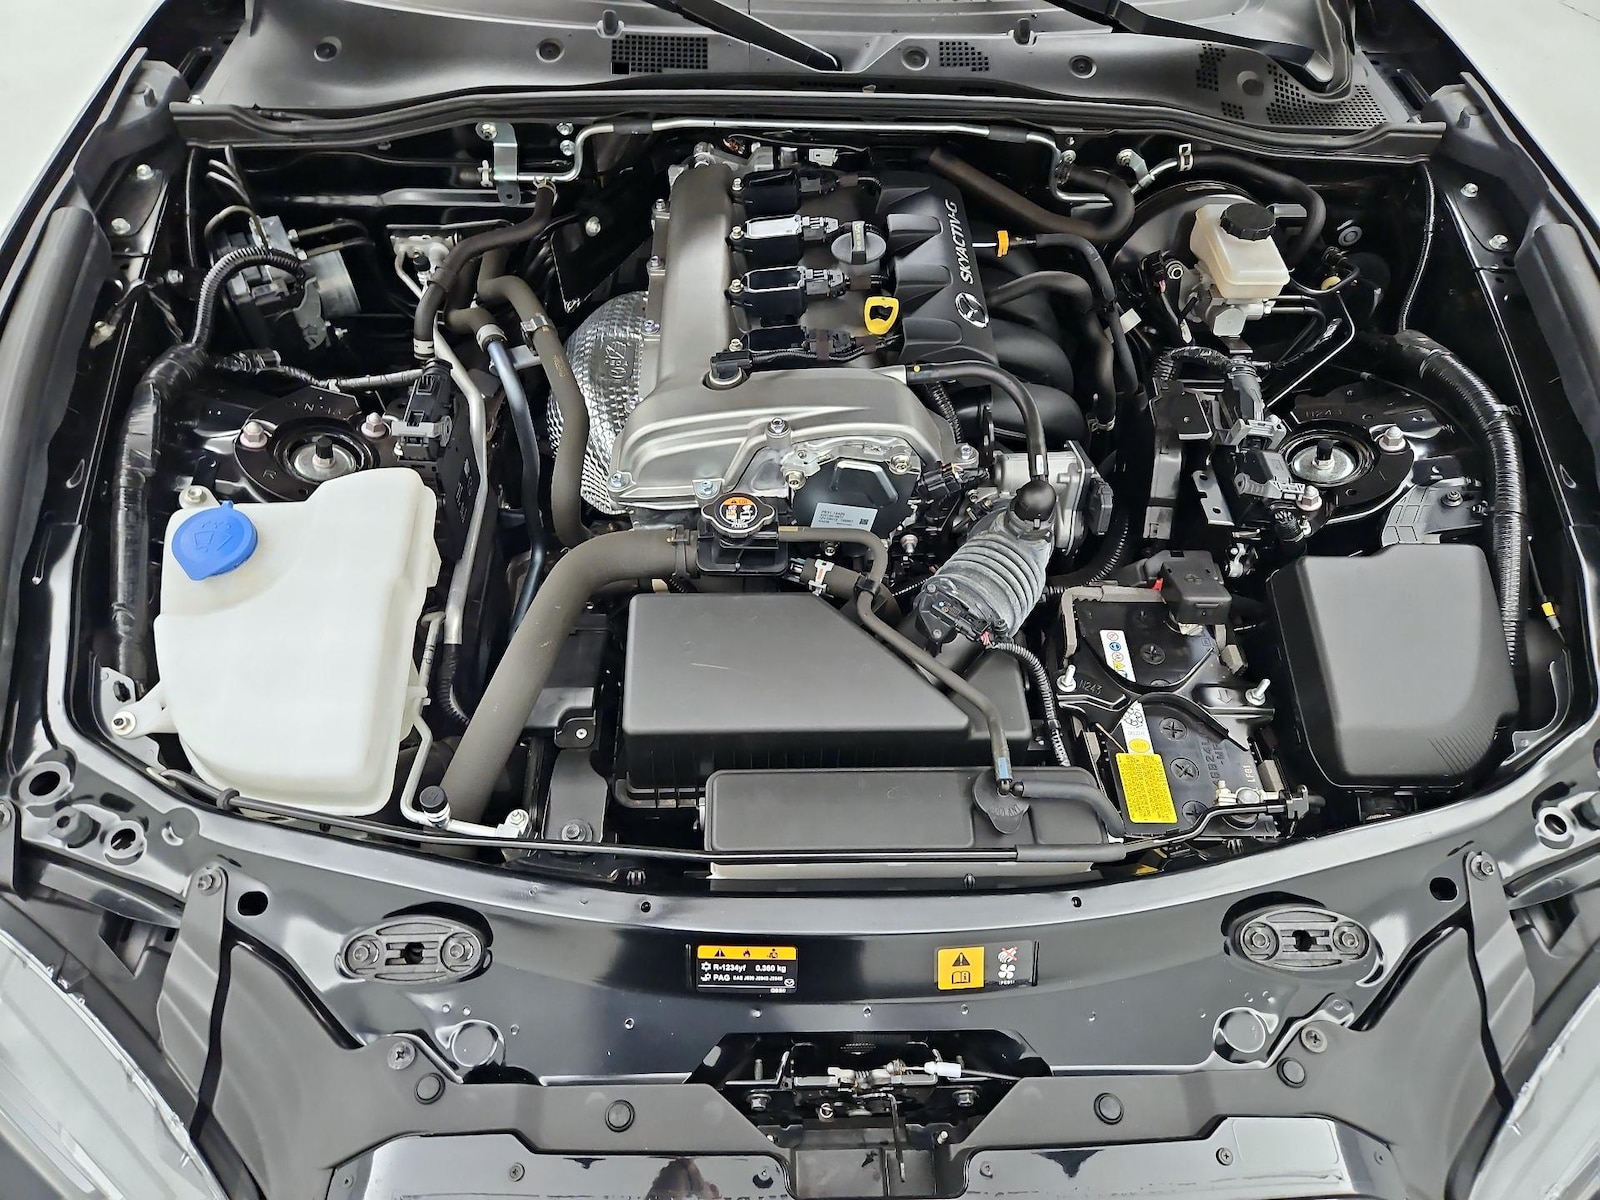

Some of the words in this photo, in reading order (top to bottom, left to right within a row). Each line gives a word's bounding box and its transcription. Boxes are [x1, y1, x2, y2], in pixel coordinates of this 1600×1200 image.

[944, 198, 974, 285] SKYACTIV-G
[712, 963, 747, 973] R-1234yf
[776, 965, 787, 973] kg
[712, 973, 731, 982] PAG
